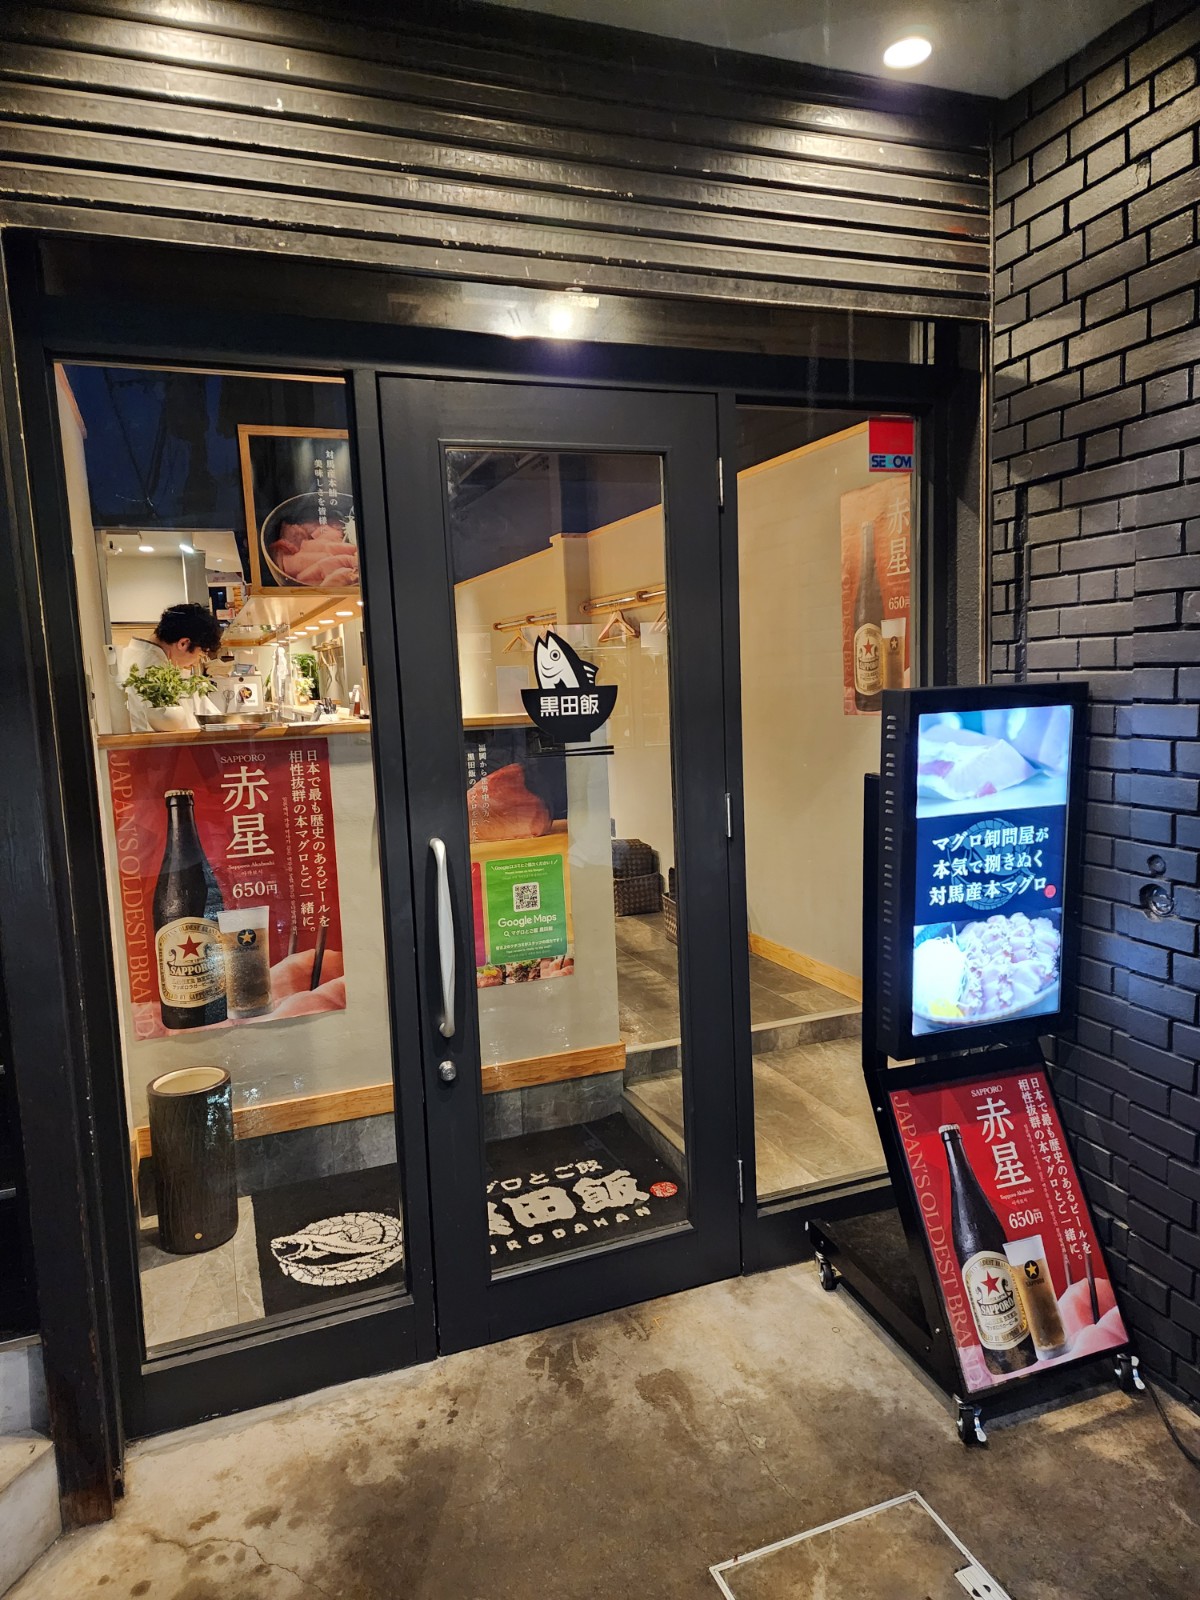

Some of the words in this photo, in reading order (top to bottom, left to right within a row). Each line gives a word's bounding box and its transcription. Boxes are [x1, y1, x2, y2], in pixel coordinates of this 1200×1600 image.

[540, 694, 599, 718] 黒田飯
[220, 753, 266, 764] SAPPORO
[109, 753, 139, 851] JAPAN'S
[221, 766, 275, 859] 赤星
[306, 750, 330, 927] 日本で最も歴史のあるビールを
[932, 825, 1049, 852] マグロ卸問屋が
[932, 849, 1043, 880] 本気で捌きぬく
[119, 854, 148, 950] OLDEST
[233, 881, 278, 898] 650円
[929, 874, 1047, 906] 対馬産本マグロ
[498, 915, 533, 928] Google
[533, 914, 557, 924] Maps
[130, 954, 155, 1036] BRAND
[971, 1085, 1003, 1098] SAPPORO
[976, 1098, 1032, 1190] 赤星
[1030, 1078, 1092, 1254] 日本で最も歴史のあるビールを
[1008, 1209, 1044, 1229] 650円
[894, 1095, 930, 1191] JAPAN'S
[920, 1192, 957, 1289] OLDEST
[947, 1293, 984, 1384] BRAND
[980, 1296, 1014, 1314] SAPPORO
